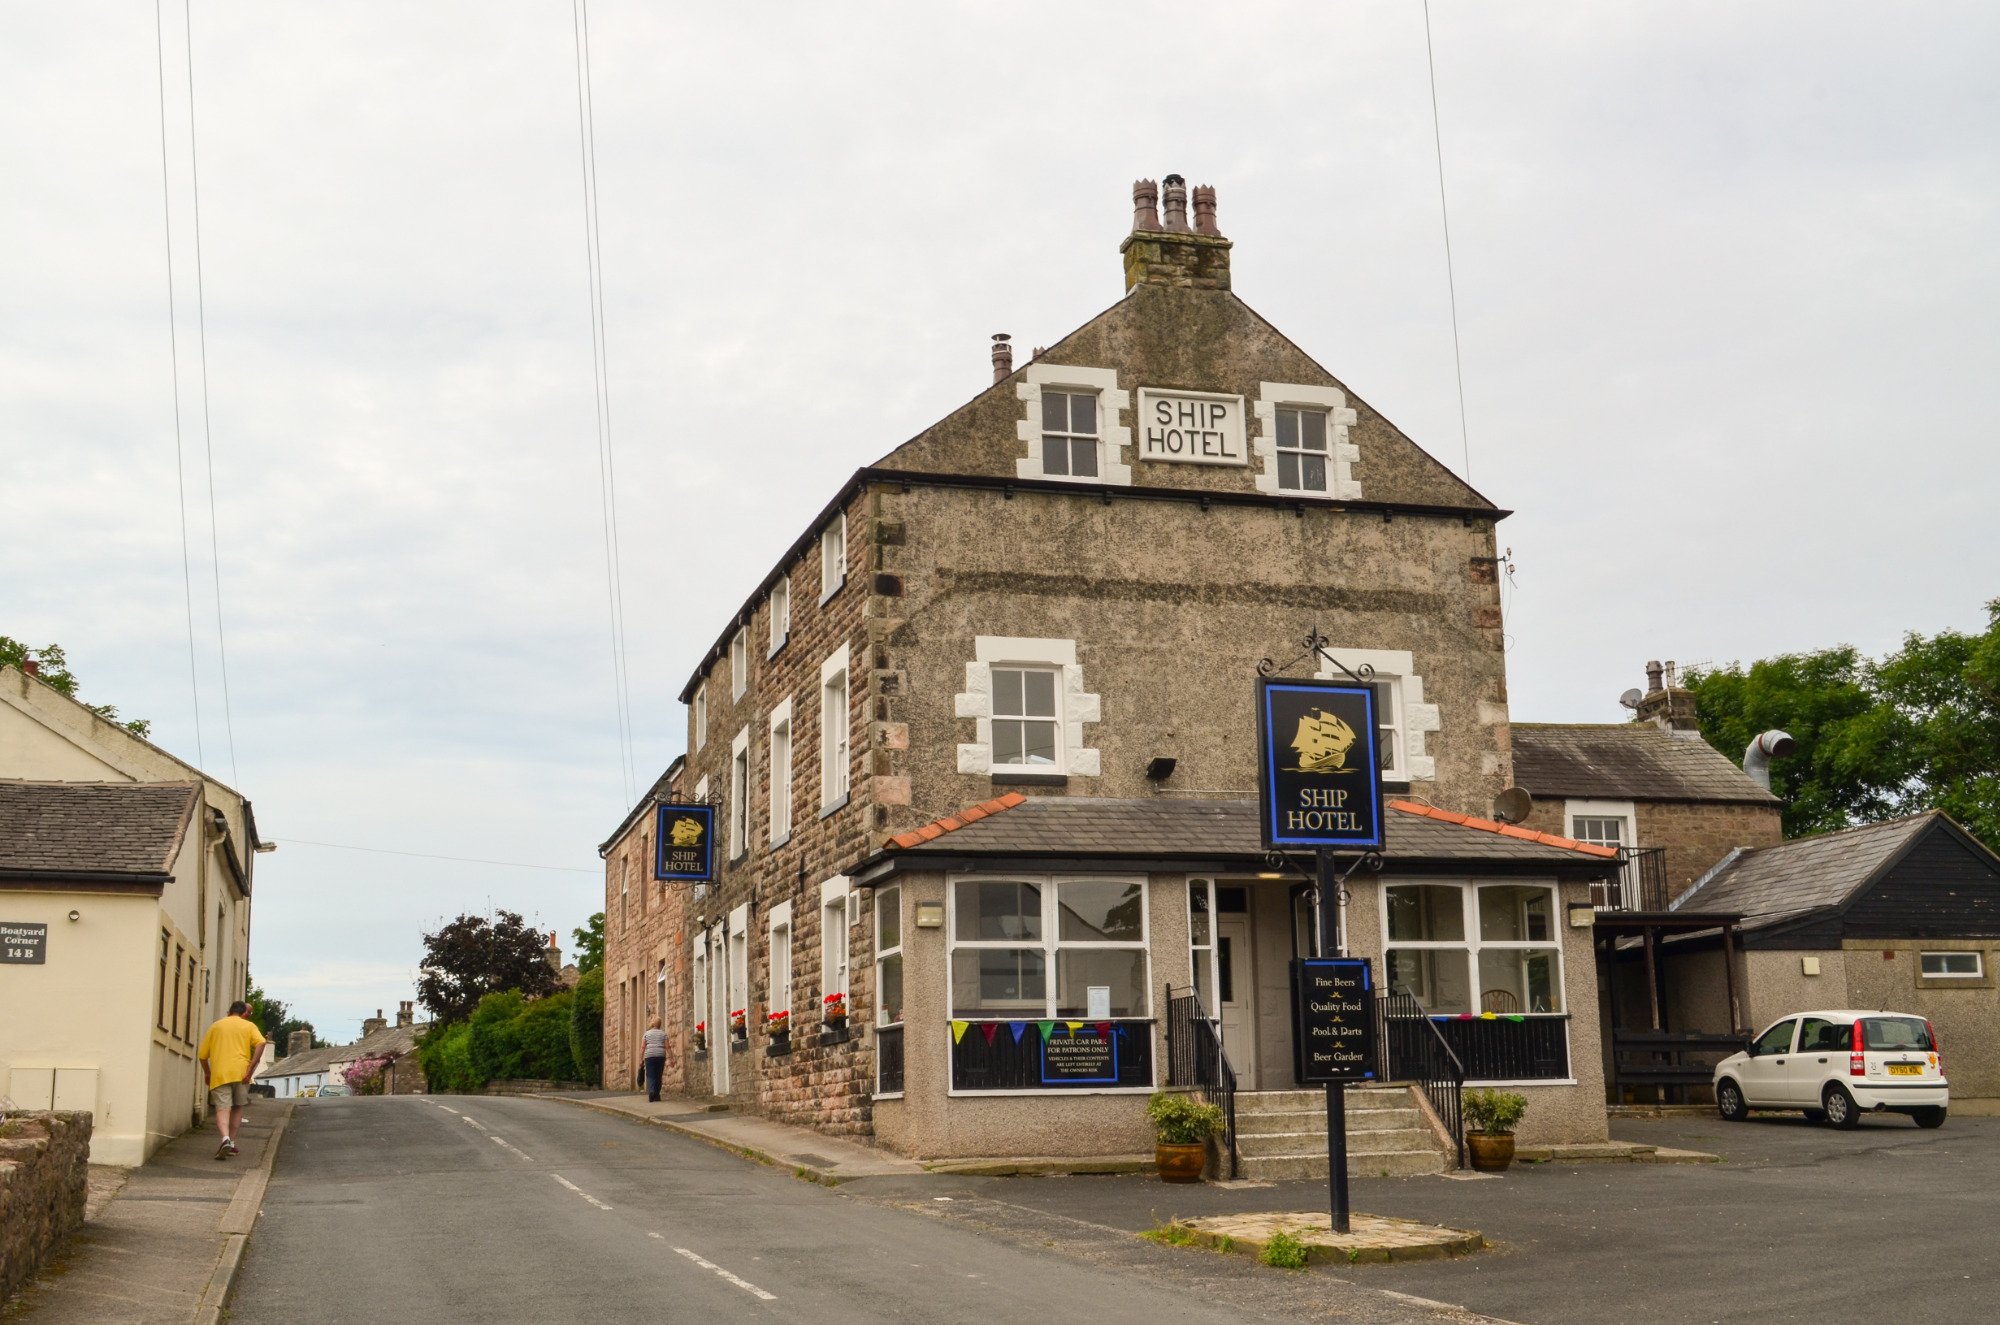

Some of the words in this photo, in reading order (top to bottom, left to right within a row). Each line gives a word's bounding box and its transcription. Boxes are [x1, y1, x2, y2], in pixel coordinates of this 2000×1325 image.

[1156, 400, 1227, 429] SHIP
[1147, 427, 1237, 458] HOTEL
[1300, 788, 1348, 808] SHIP
[1286, 810, 1363, 831] HOTEL
[672, 851, 697, 861] SHIP
[665, 861, 703, 871] HOTEL
[0, 927, 45, 936] Boatyard
[4, 936, 39, 945] Corner
[7, 949, 22, 958] 14
[24, 949, 34, 958] B
[1315, 977, 1333, 987] Fine
[1334, 977, 1356, 987] Beers
[1310, 1002, 1341, 1013] Quality
[1342, 1002, 1362, 1011] Food
[1331, 1028, 1339, 1036] &
[1340, 1027, 1363, 1036] Darts
[1091, 1046, 1109, 1054] ONLY
[1314, 1052, 1333, 1061] Beer
[1333, 1051, 1363, 1061] Garden
